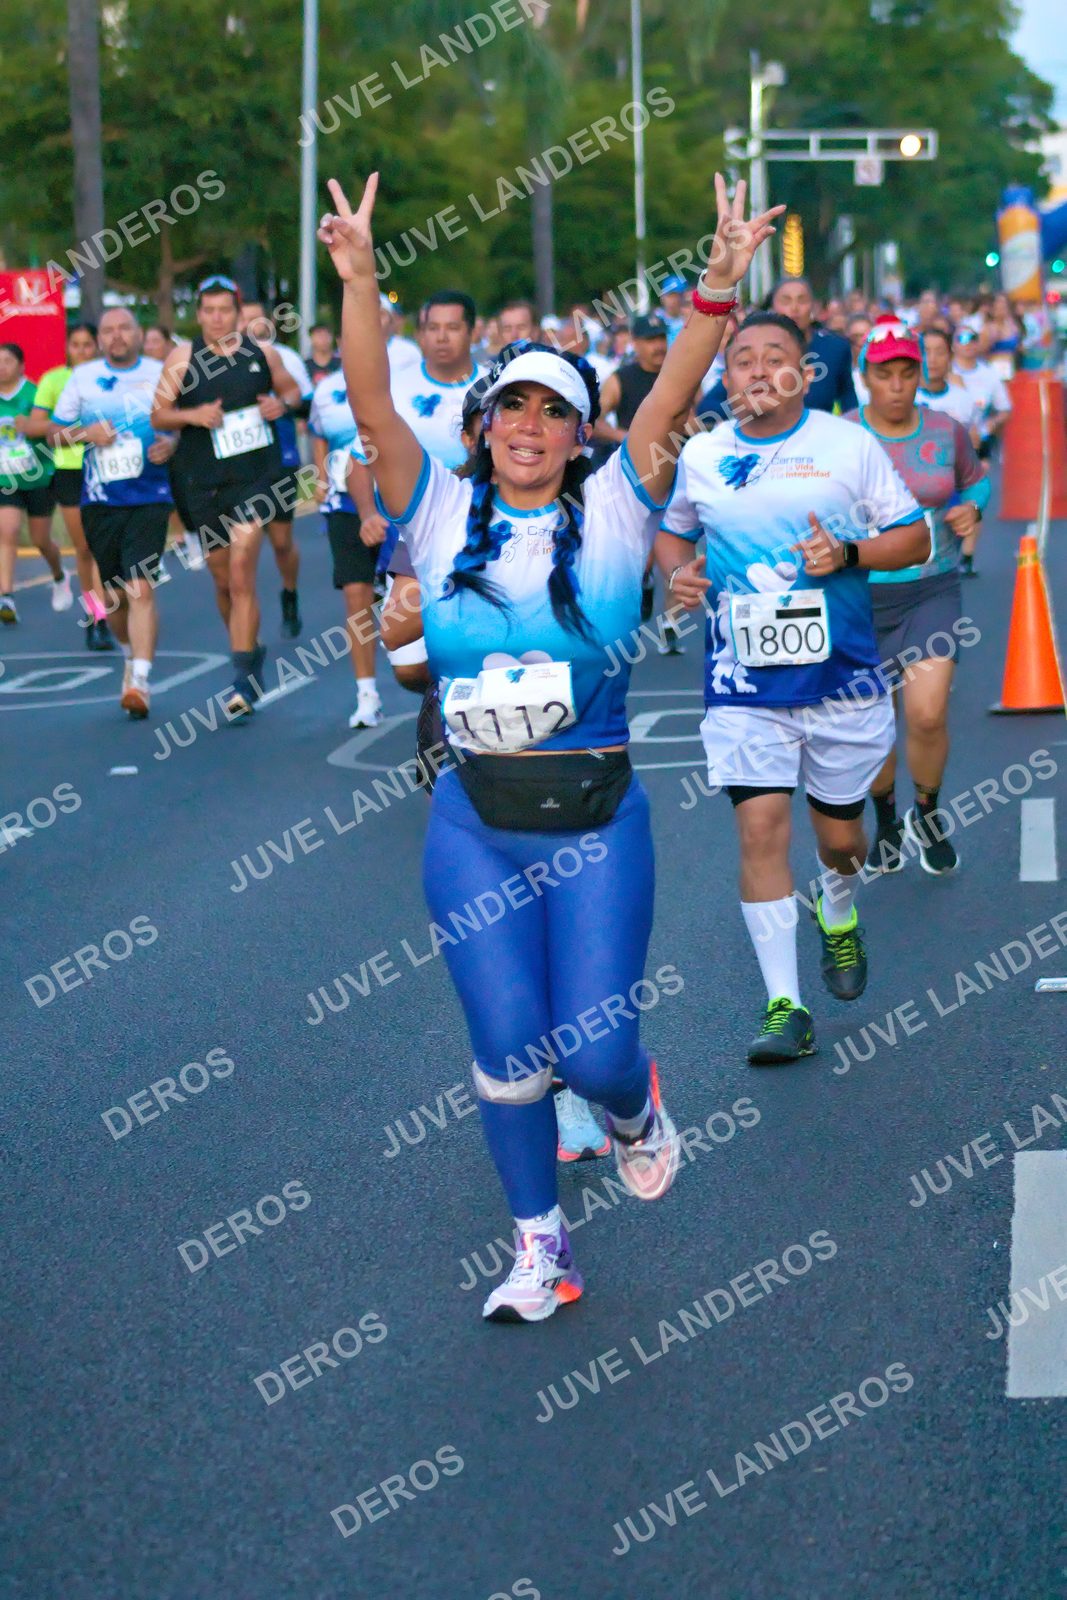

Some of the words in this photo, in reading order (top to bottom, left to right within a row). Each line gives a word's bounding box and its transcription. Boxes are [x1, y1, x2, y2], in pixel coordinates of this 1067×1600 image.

[222, 424, 263, 450] 1857
[98, 455, 142, 477] 1839
[739, 621, 825, 656] 1800
[454, 701, 569, 742] 1112
